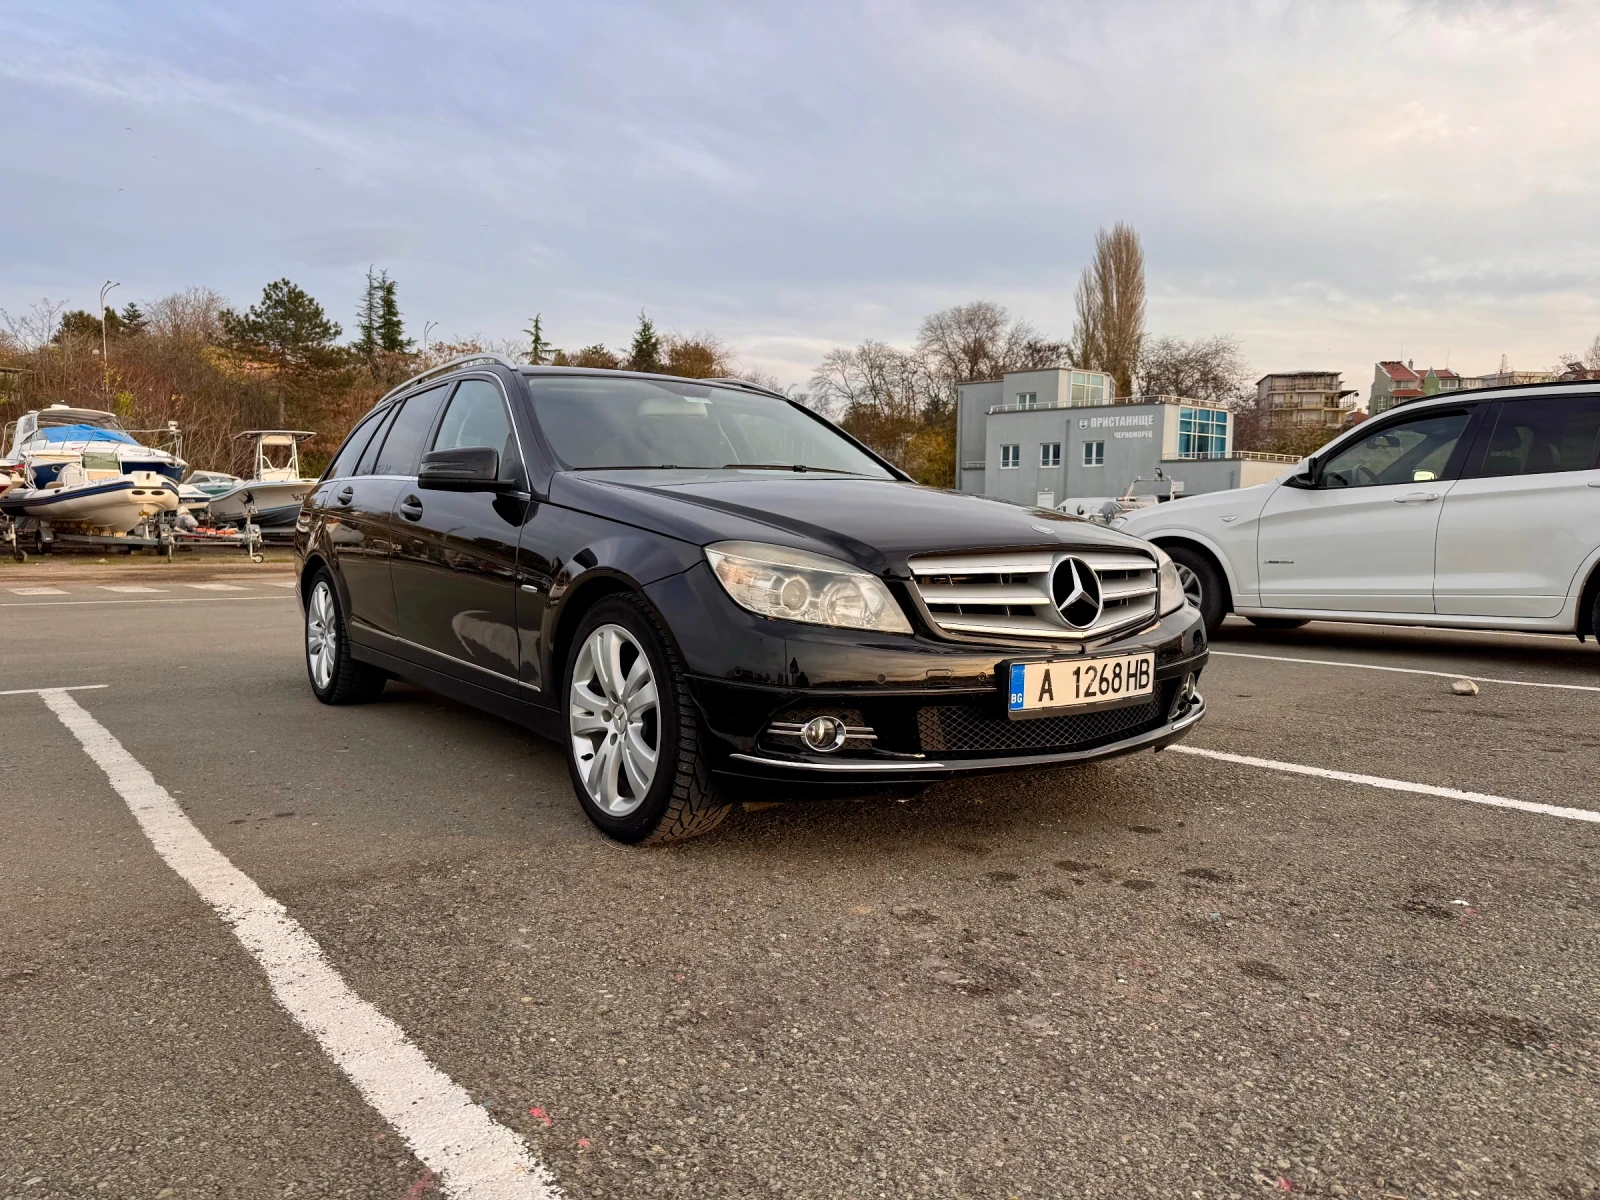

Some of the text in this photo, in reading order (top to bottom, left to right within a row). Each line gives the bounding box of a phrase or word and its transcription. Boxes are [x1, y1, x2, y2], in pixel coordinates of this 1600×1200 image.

[1090, 414, 1154, 428] ПРИСТАНИЩЕ
[1114, 430, 1153, 439] ЧЕРНОМОРЕЦ
[1038, 668, 1054, 702] A
[1010, 693, 1023, 704] BG
